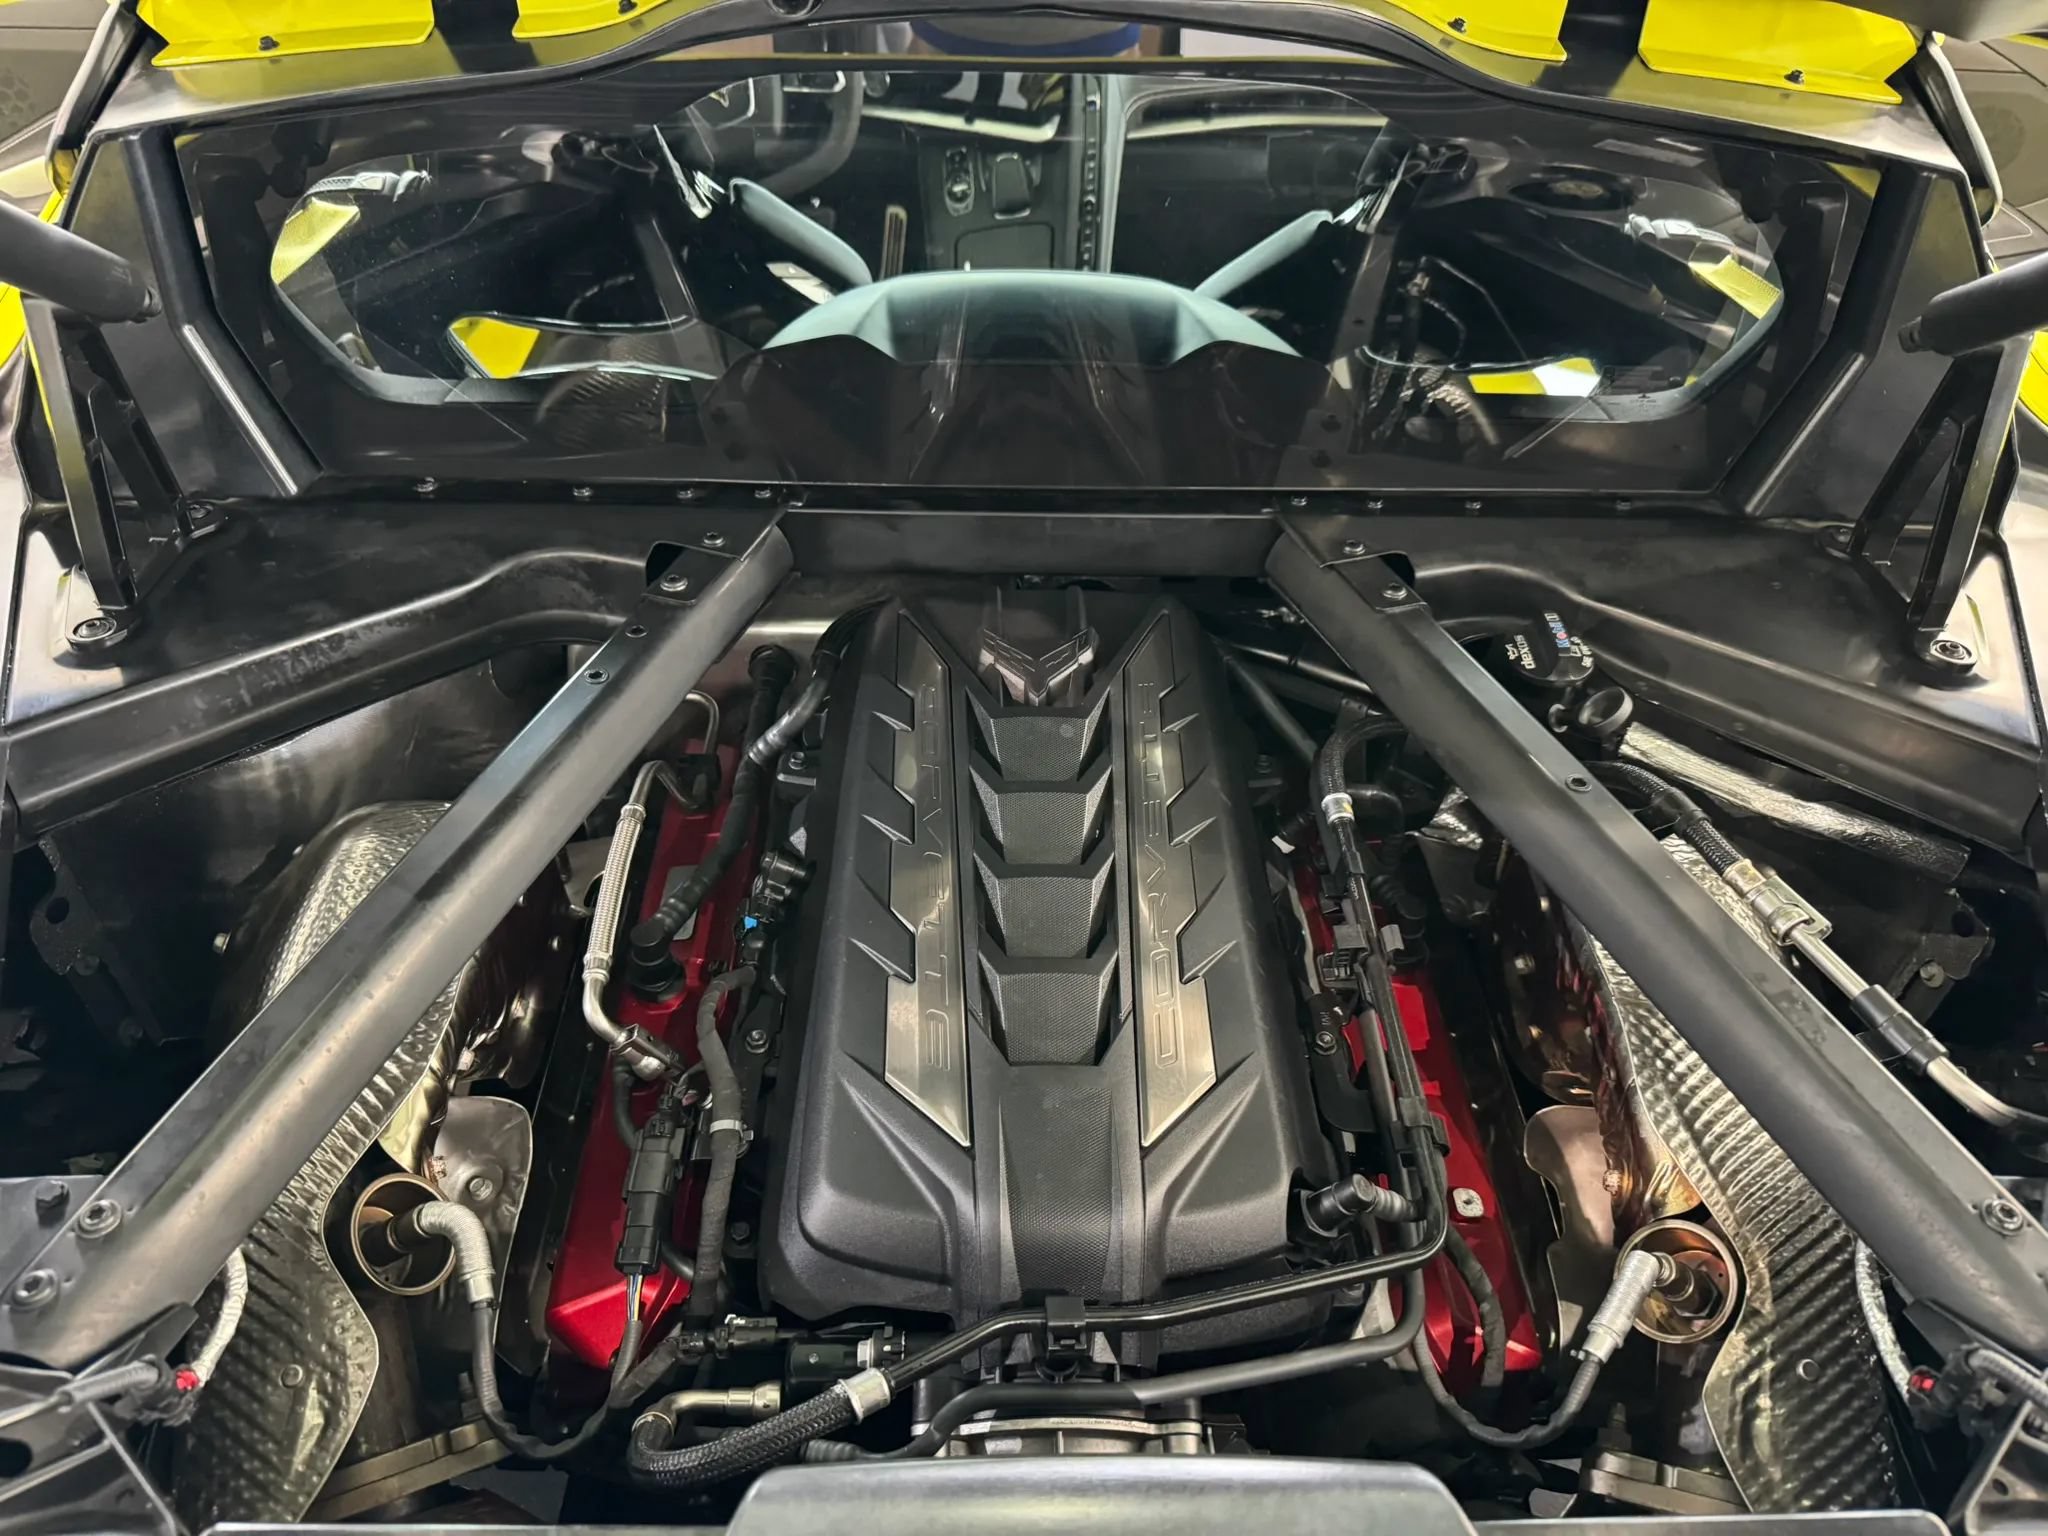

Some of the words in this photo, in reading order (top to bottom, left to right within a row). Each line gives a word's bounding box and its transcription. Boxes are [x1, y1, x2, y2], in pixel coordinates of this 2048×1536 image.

[1514, 634, 1536, 669] dexos
[919, 684, 950, 1070] CORVETTE
[1137, 682, 1179, 1071] CORVETTE
